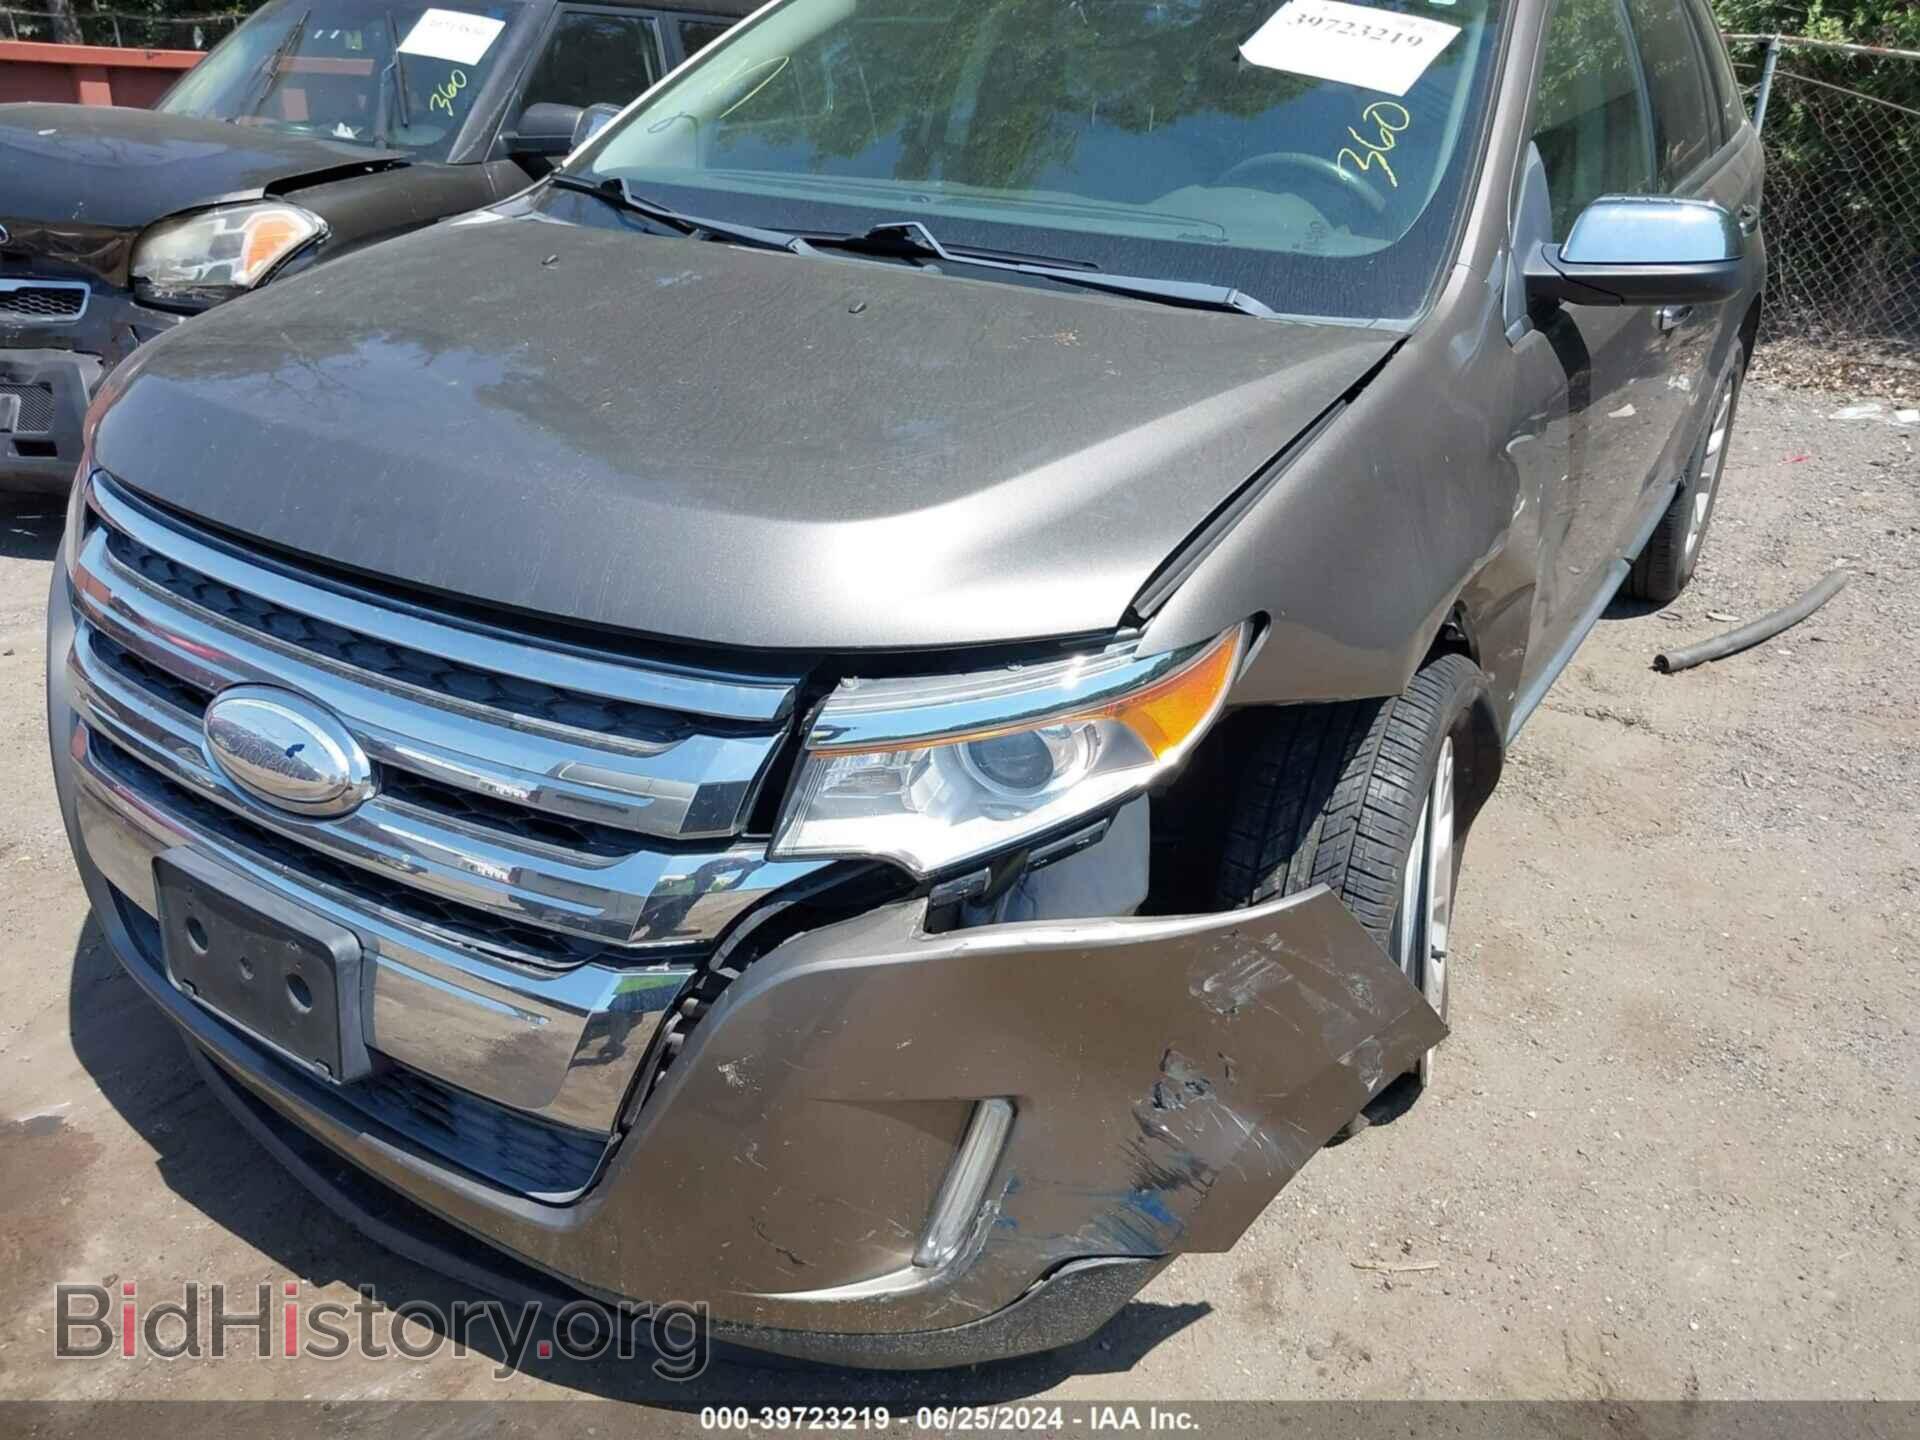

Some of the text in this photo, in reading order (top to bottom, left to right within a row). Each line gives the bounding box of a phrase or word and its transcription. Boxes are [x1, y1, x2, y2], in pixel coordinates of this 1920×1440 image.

[1287, 13, 1424, 48] 39723219
[429, 69, 467, 117] 360
[1336, 101, 1410, 188] 360
